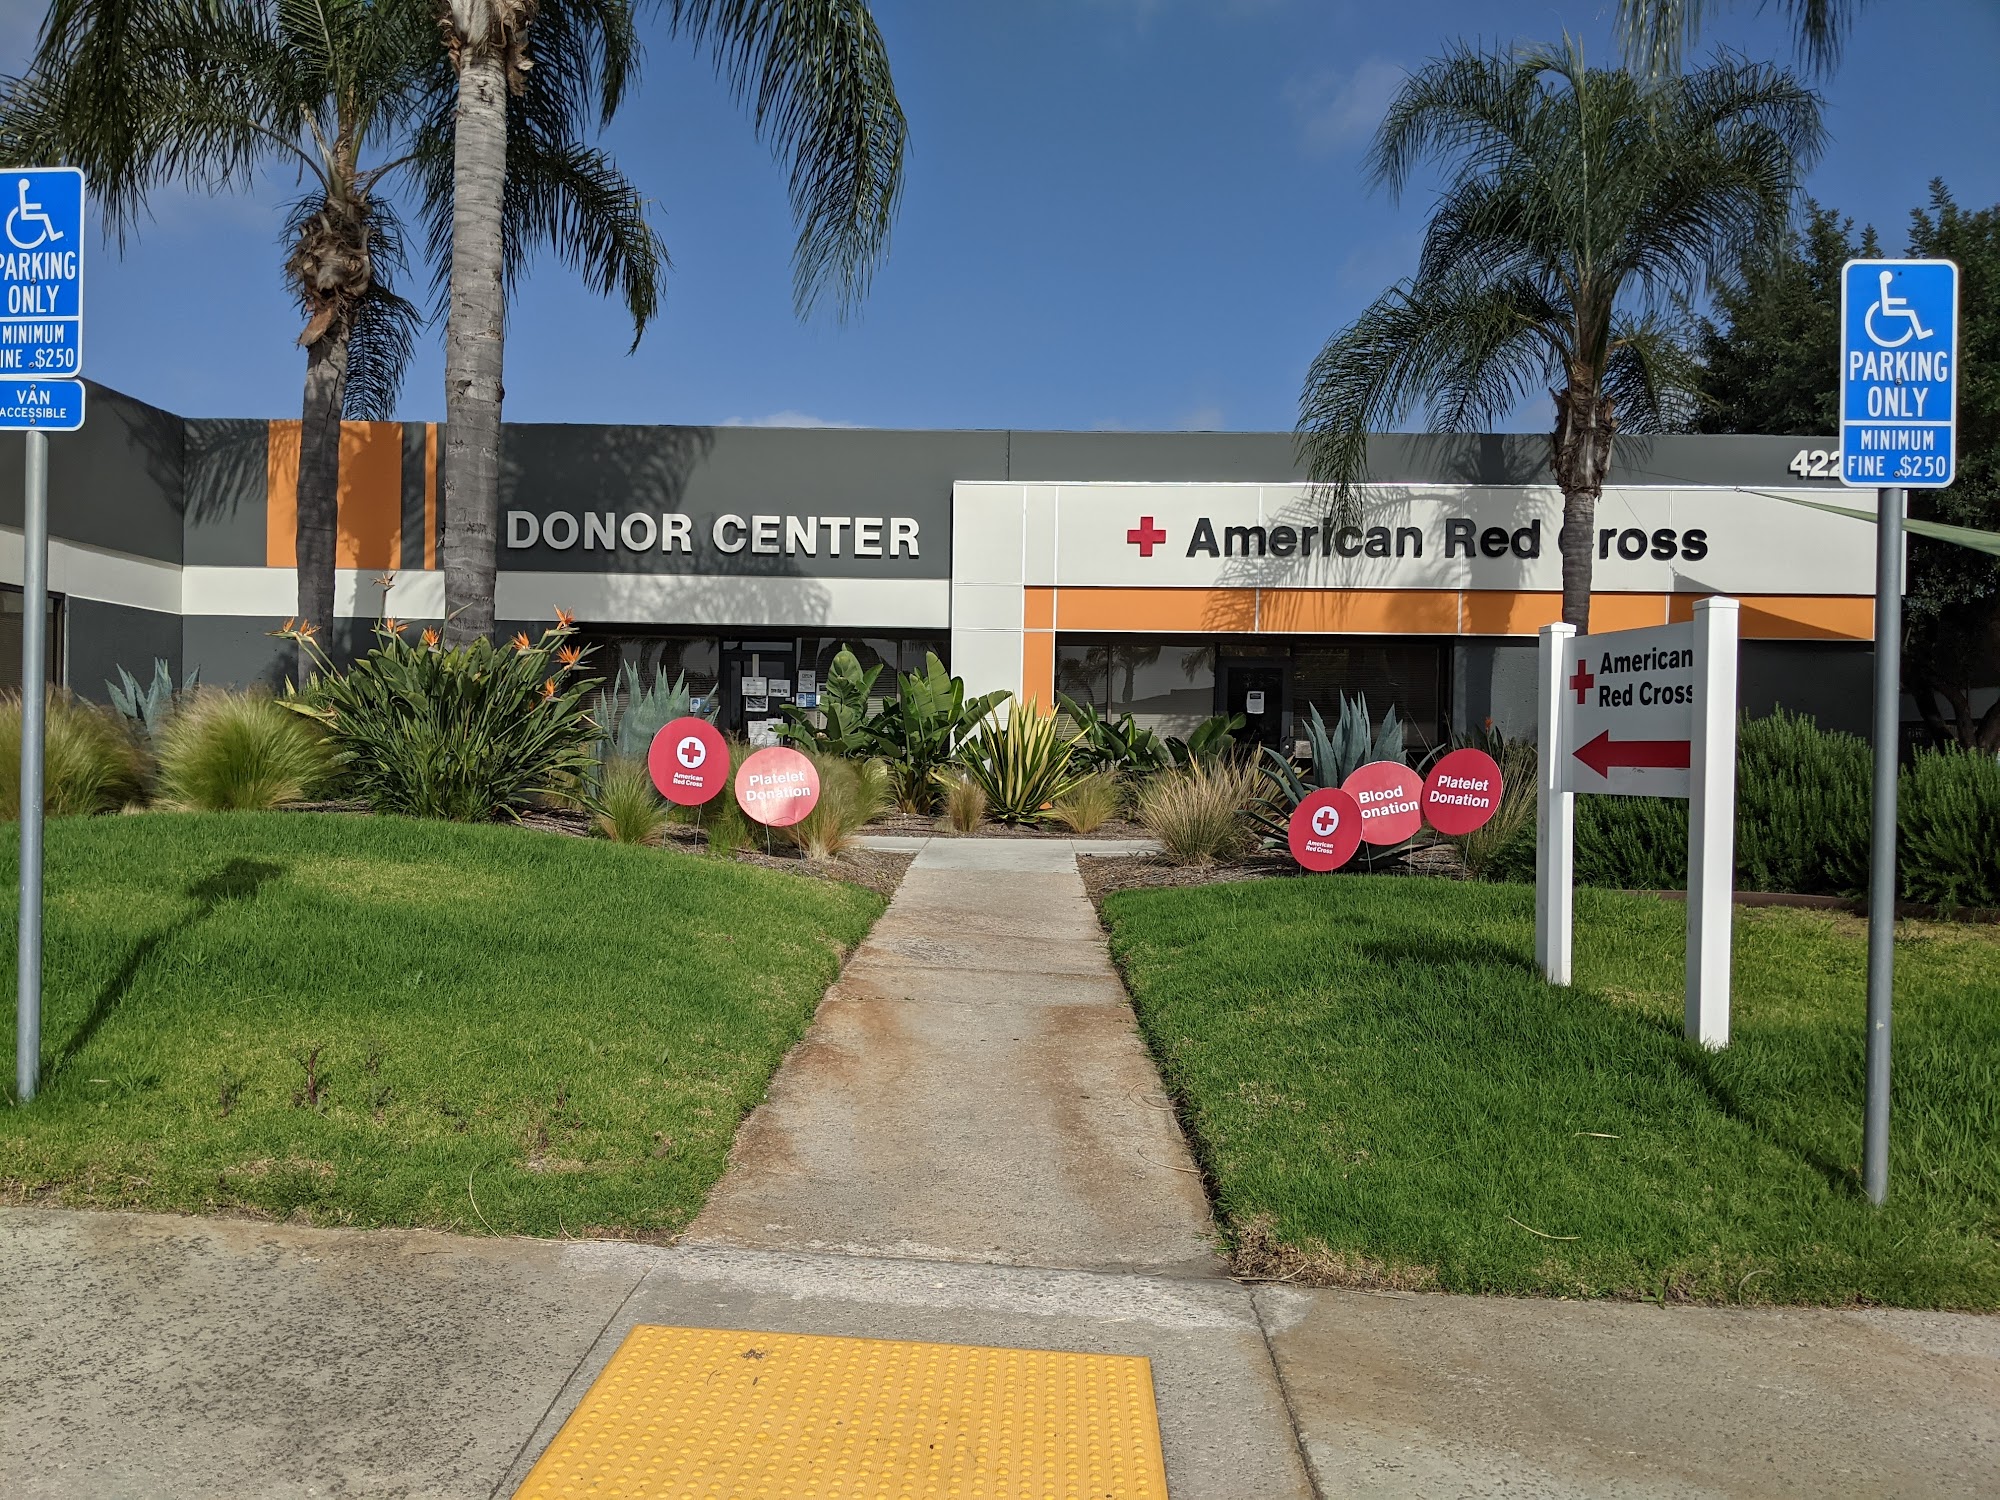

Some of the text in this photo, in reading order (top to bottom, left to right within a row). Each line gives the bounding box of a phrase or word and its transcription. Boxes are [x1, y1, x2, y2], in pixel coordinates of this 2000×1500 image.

[8, 285, 60, 314] ONLY
[2, 324, 65, 344] MINIMUM
[0, 347, 75, 369] INE $250
[1850, 351, 1948, 382] PARKING
[16, 389, 51, 405] VAN
[1867, 386, 1929, 418] ONLY
[0, 407, 67, 418] ACCESSIBLE
[1860, 429, 1934, 451] MINIMUM
[1847, 454, 1946, 478] FINE $250
[506, 510, 920, 556] DONOR CENTER
[1186, 517, 1709, 562] American Red ross
[1599, 646, 1693, 675] American
[1598, 683, 1633, 708] Red
[672, 777, 703, 788] Red Cross
[673, 771, 703, 782] American
[749, 770, 805, 787] Platelet
[1437, 774, 1489, 792] Platelet
[745, 786, 811, 802] Donation
[1358, 785, 1404, 804] Blood
[1429, 790, 1490, 809] Donation
[1361, 800, 1419, 819] onation
[1305, 845, 1333, 855] Red Cross
[1307, 839, 1334, 849] American
